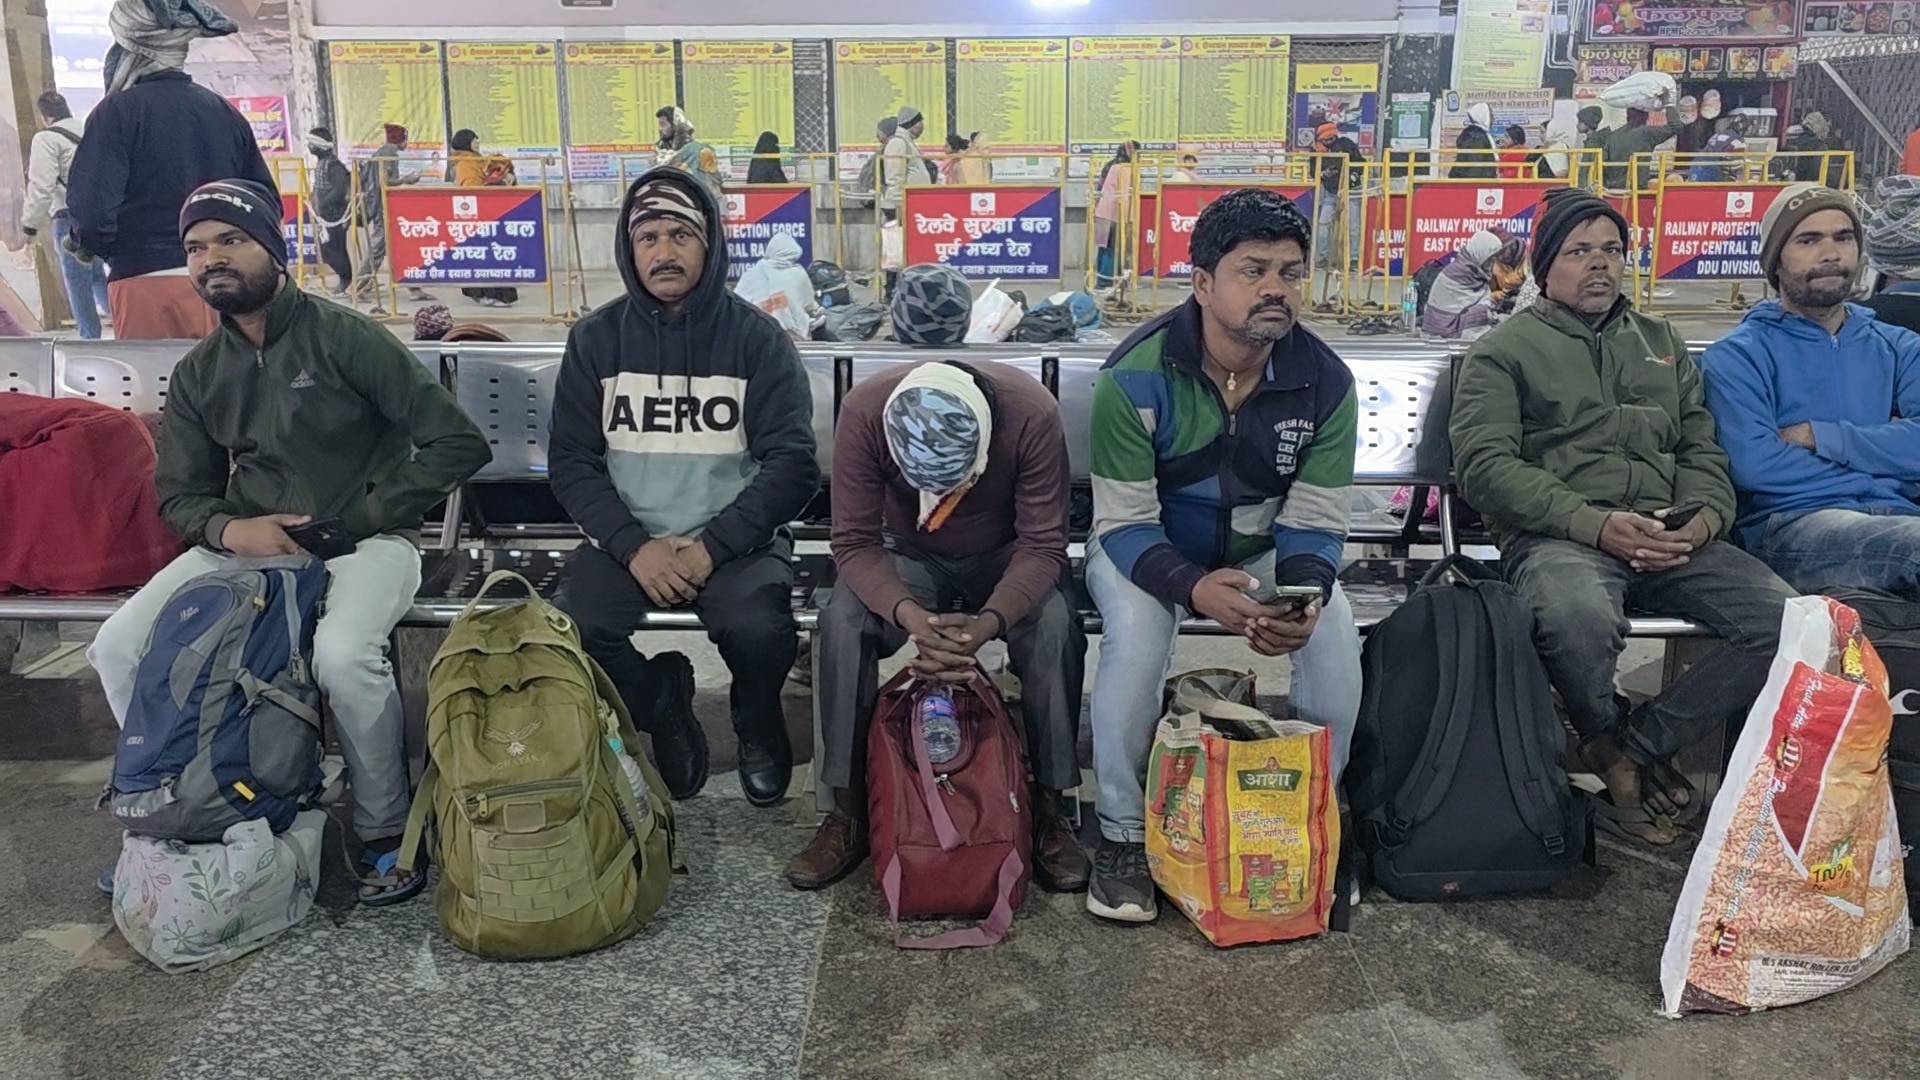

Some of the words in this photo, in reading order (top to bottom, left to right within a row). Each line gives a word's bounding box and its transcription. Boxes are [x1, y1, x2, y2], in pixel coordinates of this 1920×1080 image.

[1581, 48, 1610, 60] फल
[1613, 48, 1641, 64] जूस
[397, 216, 441, 238] रेलवे
[446, 220, 500, 243] सुरक्षा
[503, 220, 536, 238] बल
[724, 223, 770, 239] TECTION
[914, 213, 958, 235] रेलवे
[962, 217, 1016, 240] सुरक्षा
[1020, 216, 1052, 234] बल
[1416, 218, 1461, 233] RAILWAY
[1665, 221, 1709, 236] RAILWAY
[1711, 221, 1763, 237] PROTECTI
[934, 238, 962, 263] पूर्व
[965, 242, 1003, 257] मध्य
[1005, 238, 1032, 258] रेल
[1424, 237, 1451, 252] EAST
[1671, 240, 1699, 255] EAST
[1701, 240, 1748, 255] CENTRAL
[420, 241, 447, 266] पूर्व
[450, 245, 488, 261] मध्य
[491, 241, 517, 261] रेल
[403, 266, 427, 279] पंडित
[429, 266, 445, 279] दीन
[448, 268, 472, 279] दयाल
[473, 268, 512, 279] उपाध्याय
[514, 265, 536, 279] मंडल
[961, 264, 985, 275] दयाल
[987, 264, 1025, 275] उपाध्याय
[1027, 261, 1049, 275] मंडल
[1697, 260, 1719, 275] DDU
[1721, 260, 1764, 275] DIVISIO
[607, 394, 740, 434] AERO
[1273, 418, 1297, 433] FRESH
[1244, 773, 1292, 788] आशा
[116, 806, 129, 817] 45
[1812, 862, 1852, 883] 100%
[1809, 962, 1841, 973] ROLLER
